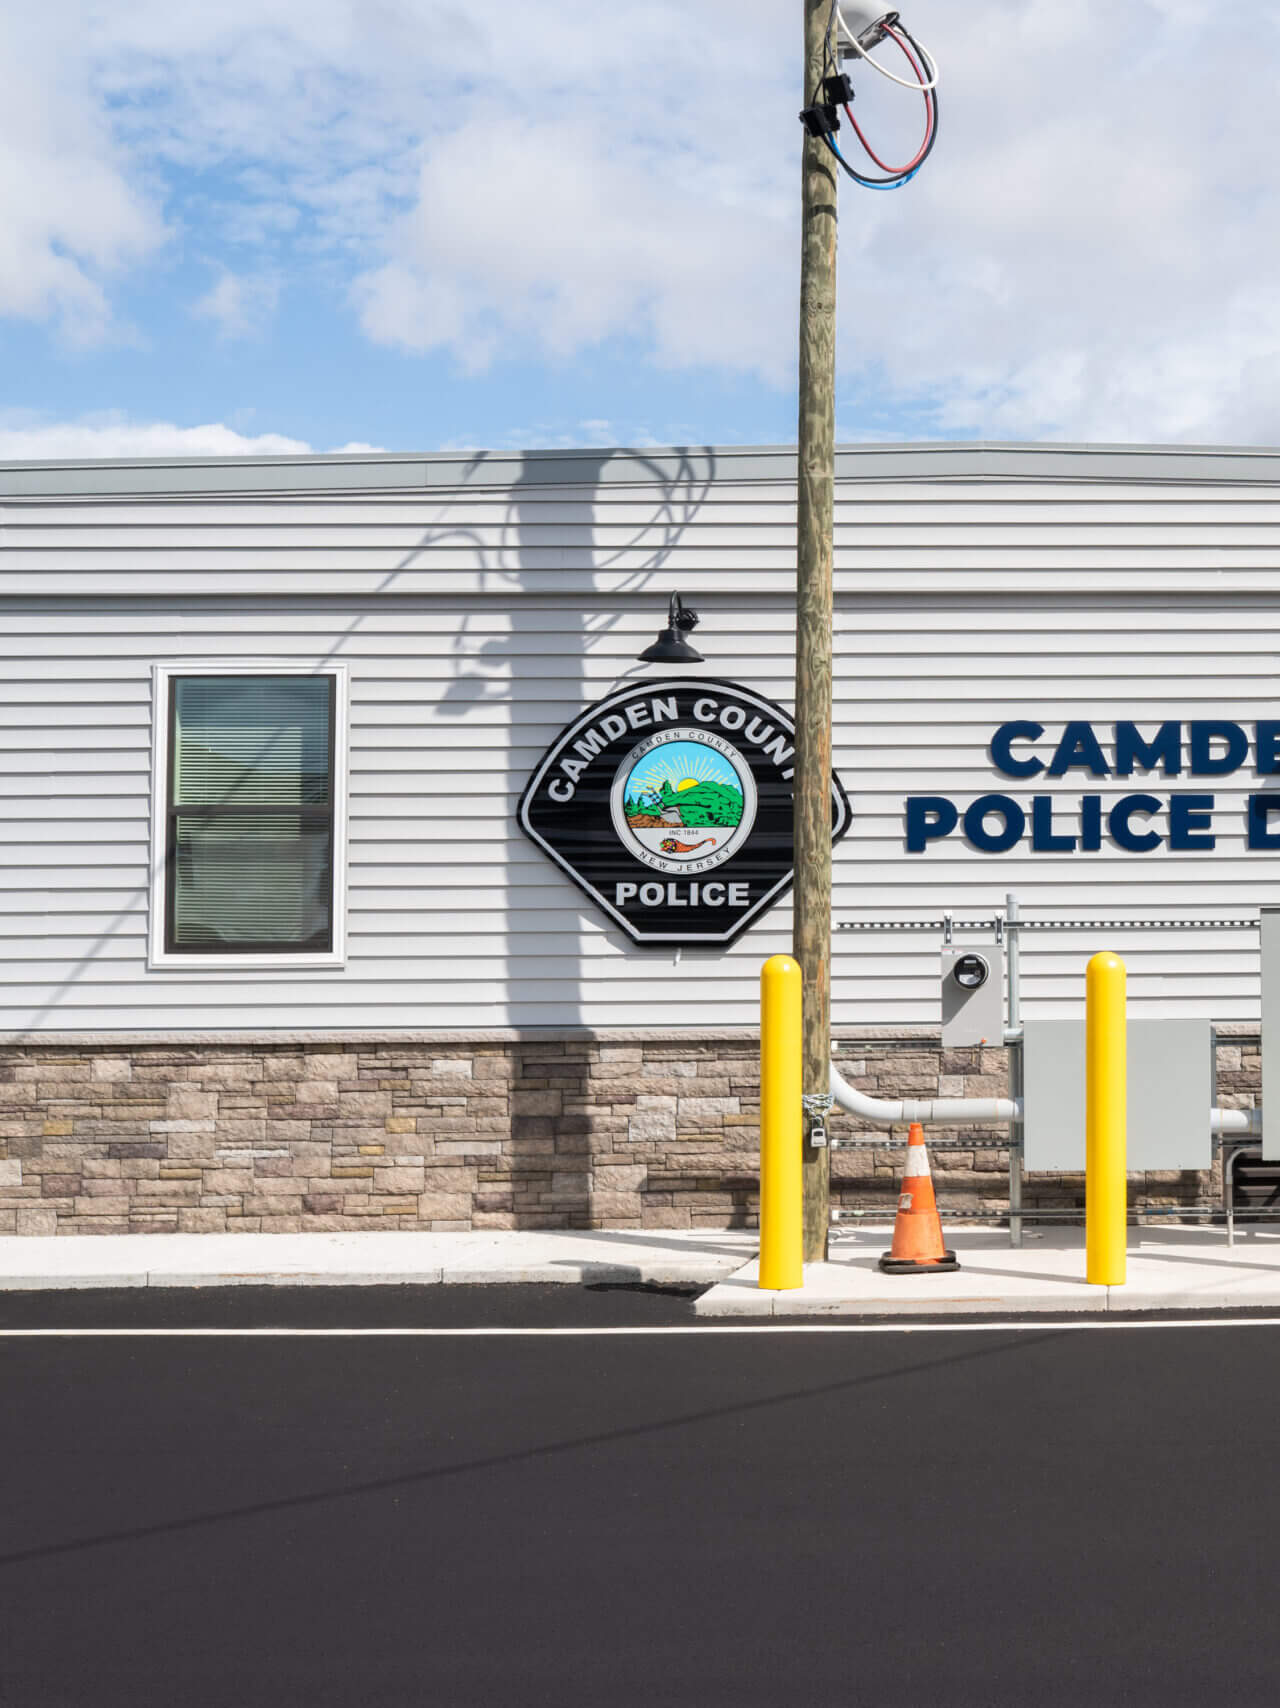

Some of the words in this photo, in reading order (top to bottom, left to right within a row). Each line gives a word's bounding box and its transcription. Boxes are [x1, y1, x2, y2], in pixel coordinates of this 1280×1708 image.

[549, 697, 679, 802] CAMDEN
[693, 698, 795, 800] COUN
[632, 732, 680, 759] CAMDEN
[688, 731, 738, 758] COUNTY
[904, 793, 1217, 853] POLICE
[639, 850, 669, 870] NEW
[677, 847, 730, 871] JERSEY
[615, 883, 749, 907] POLICE
